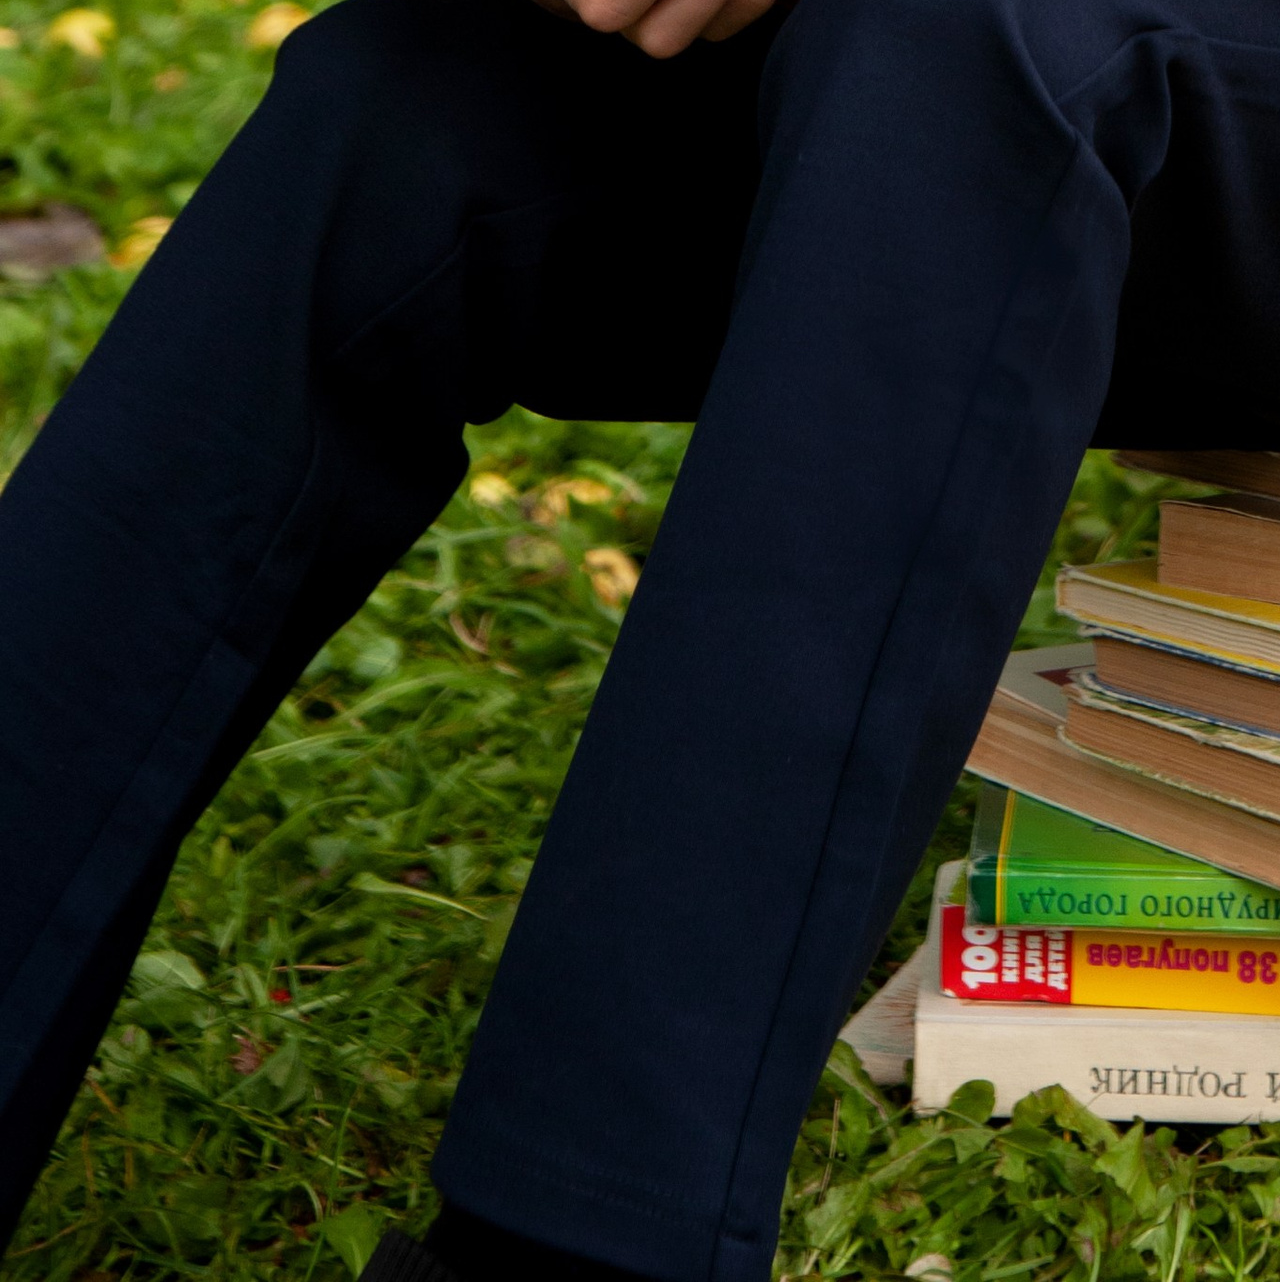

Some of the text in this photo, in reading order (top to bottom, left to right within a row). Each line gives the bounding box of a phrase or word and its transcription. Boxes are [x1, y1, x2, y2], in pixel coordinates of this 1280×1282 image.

[1017, 886, 1128, 916] ГОРОДА
[1024, 934, 1047, 984] ДЛЯ
[1087, 938, 1278, 985] 38 попугаев
[1089, 1065, 1247, 1098] РОДНИК
